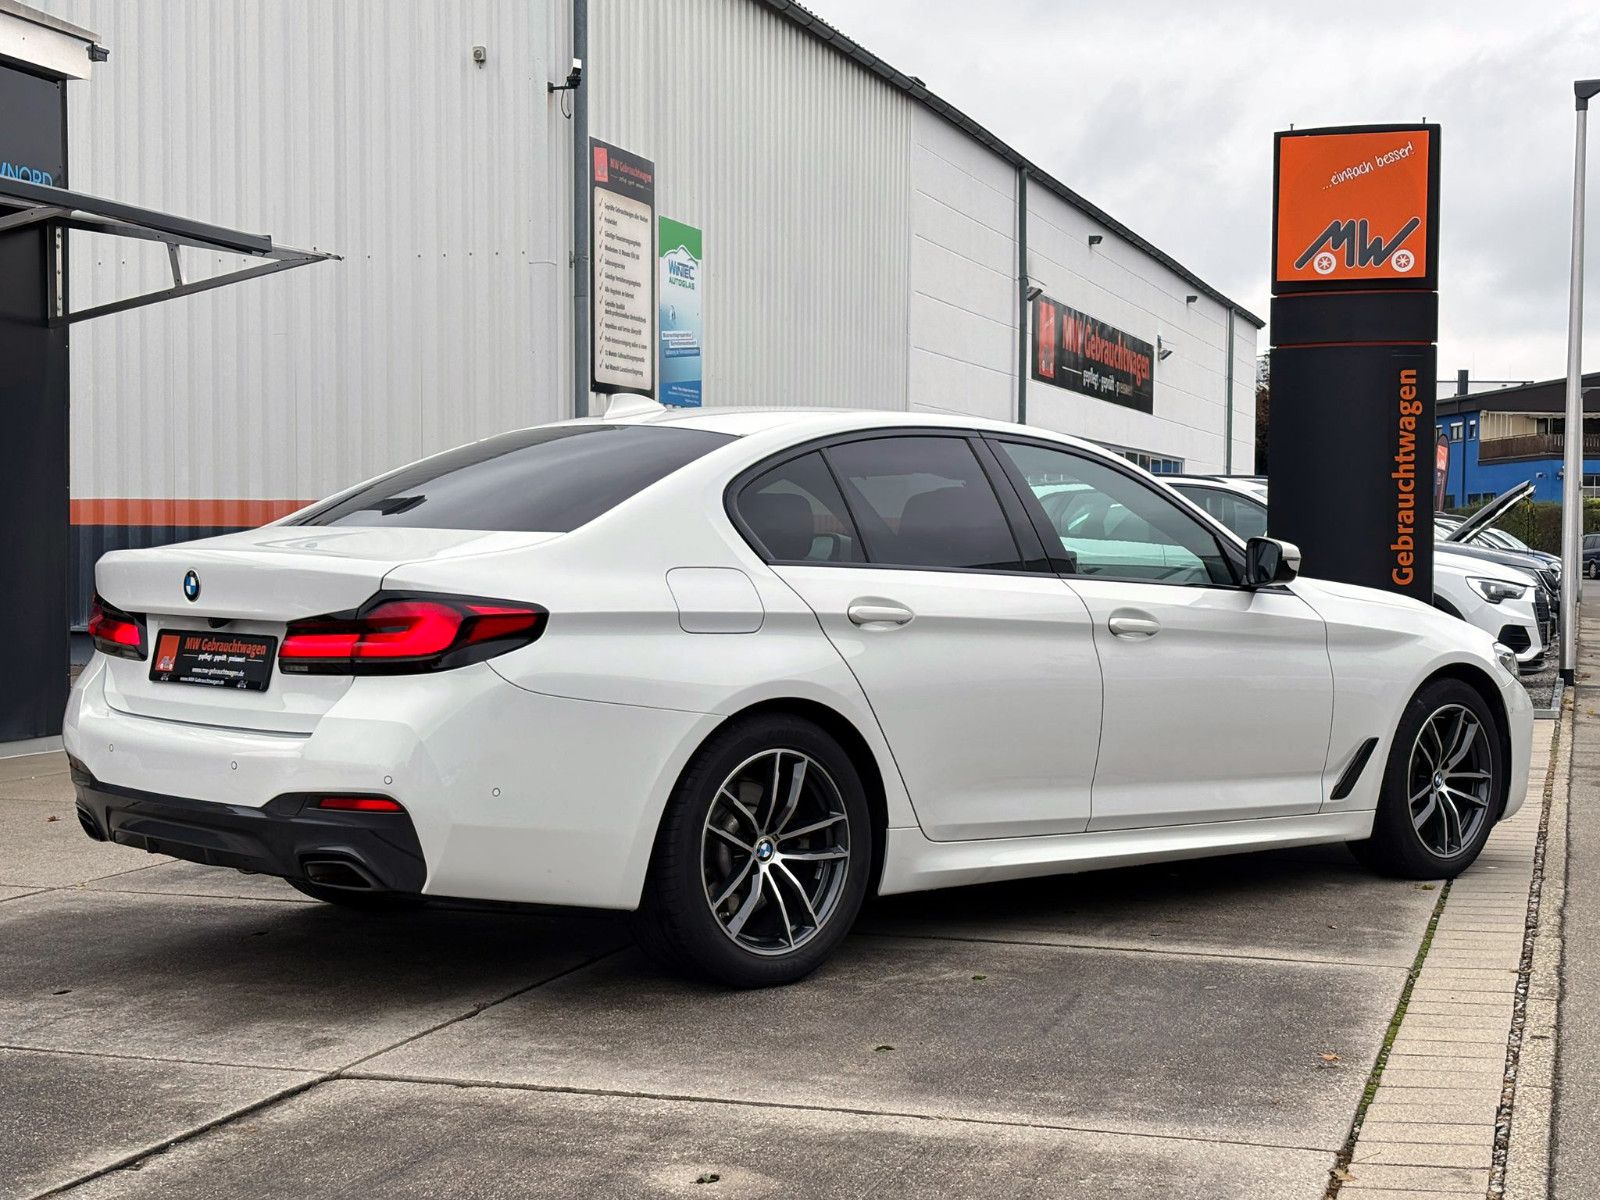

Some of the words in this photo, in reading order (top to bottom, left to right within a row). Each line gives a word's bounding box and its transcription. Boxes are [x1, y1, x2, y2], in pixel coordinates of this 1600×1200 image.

[1323, 162, 1374, 190] ...einfach
[1375, 141, 1415, 167] besser!
[1294, 216, 1421, 270] MW
[1063, 315, 1082, 353] MW
[1085, 324, 1149, 386] Gebrauchtwagen
[1391, 369, 1423, 586] Gebrauchtwagen
[185, 637, 200, 650] MW
[202, 637, 267, 658] Gebrauchtwagen
